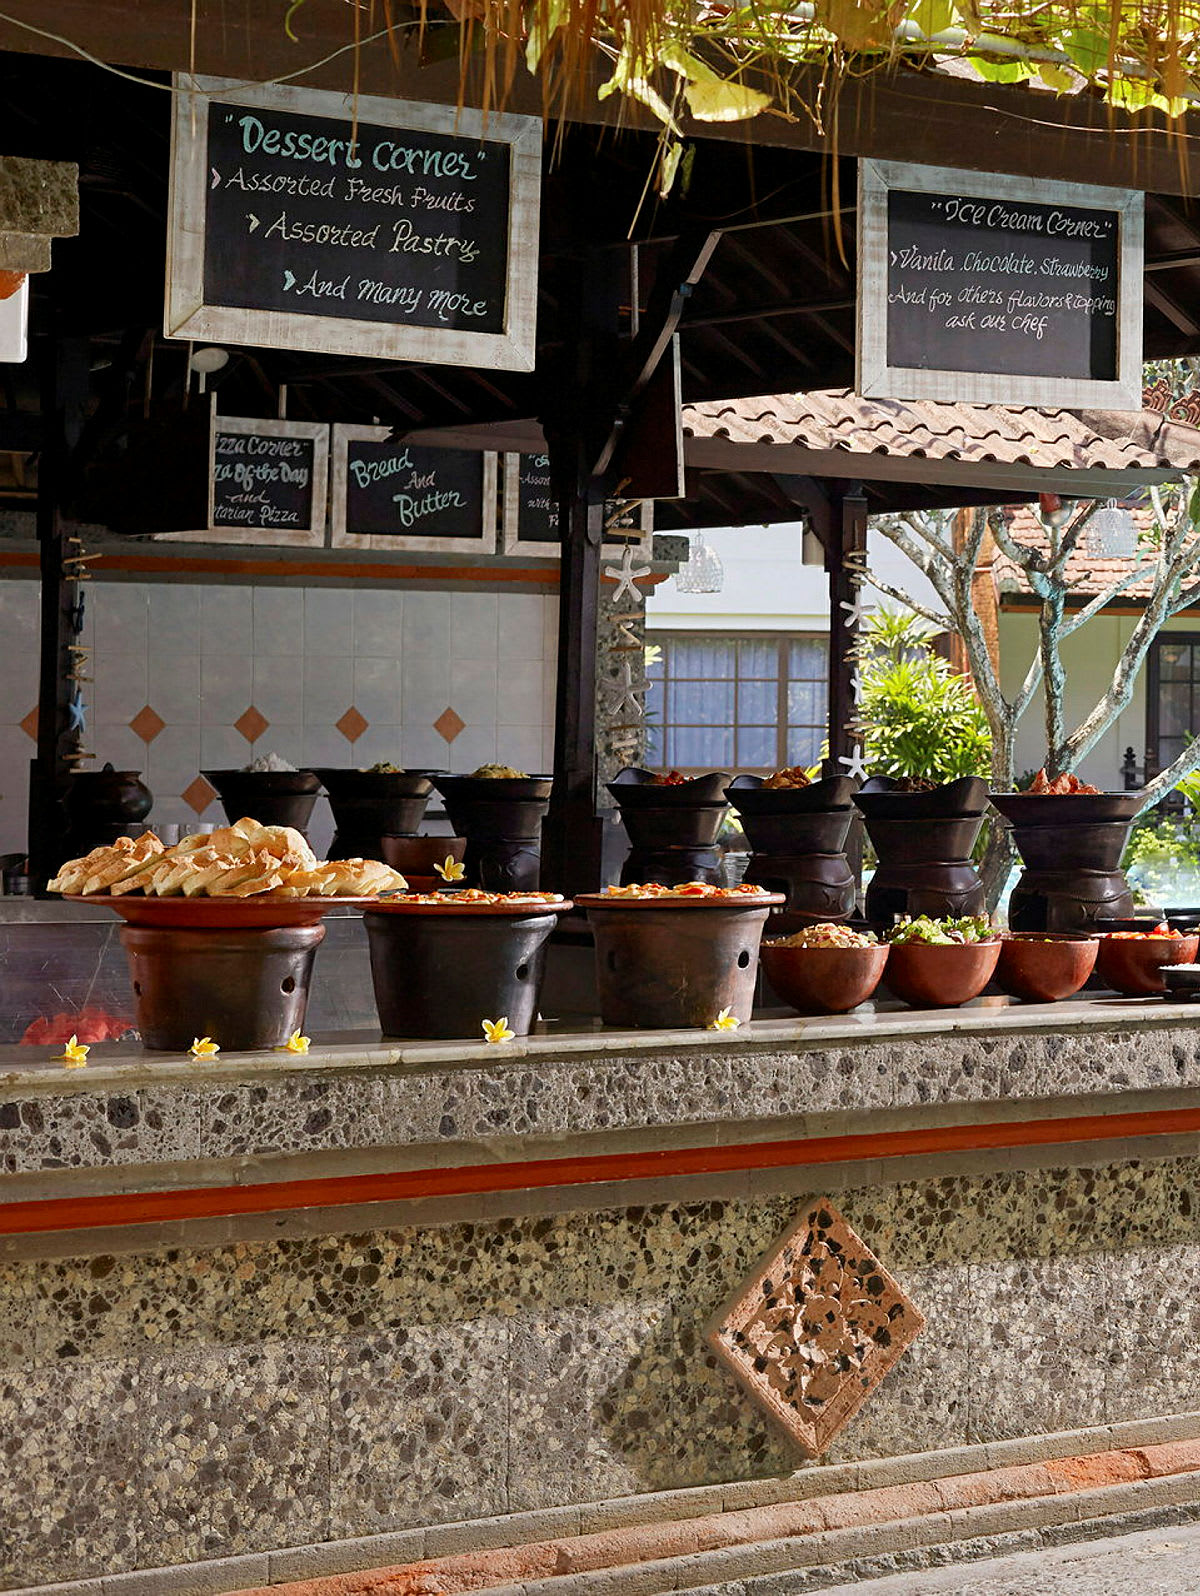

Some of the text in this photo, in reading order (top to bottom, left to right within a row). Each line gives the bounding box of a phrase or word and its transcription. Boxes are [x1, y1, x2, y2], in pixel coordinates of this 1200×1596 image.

[225, 167, 475, 213] Assorted Fresh Fruits
[987, 205, 1044, 231] Cream
[265, 211, 481, 263] Assorted Pastry
[898, 244, 955, 271] Vanila
[1040, 257, 1109, 282] Strawberry
[296, 270, 351, 301] And
[357, 278, 422, 314] Many
[888, 284, 926, 305] And
[929, 288, 953, 312] for
[945, 312, 1049, 340] ask our chef
[215, 433, 246, 454] izza
[350, 448, 414, 488] Bread
[403, 470, 436, 489] And
[215, 504, 300, 526] tarian Pizza
[392, 490, 467, 527] Butter
